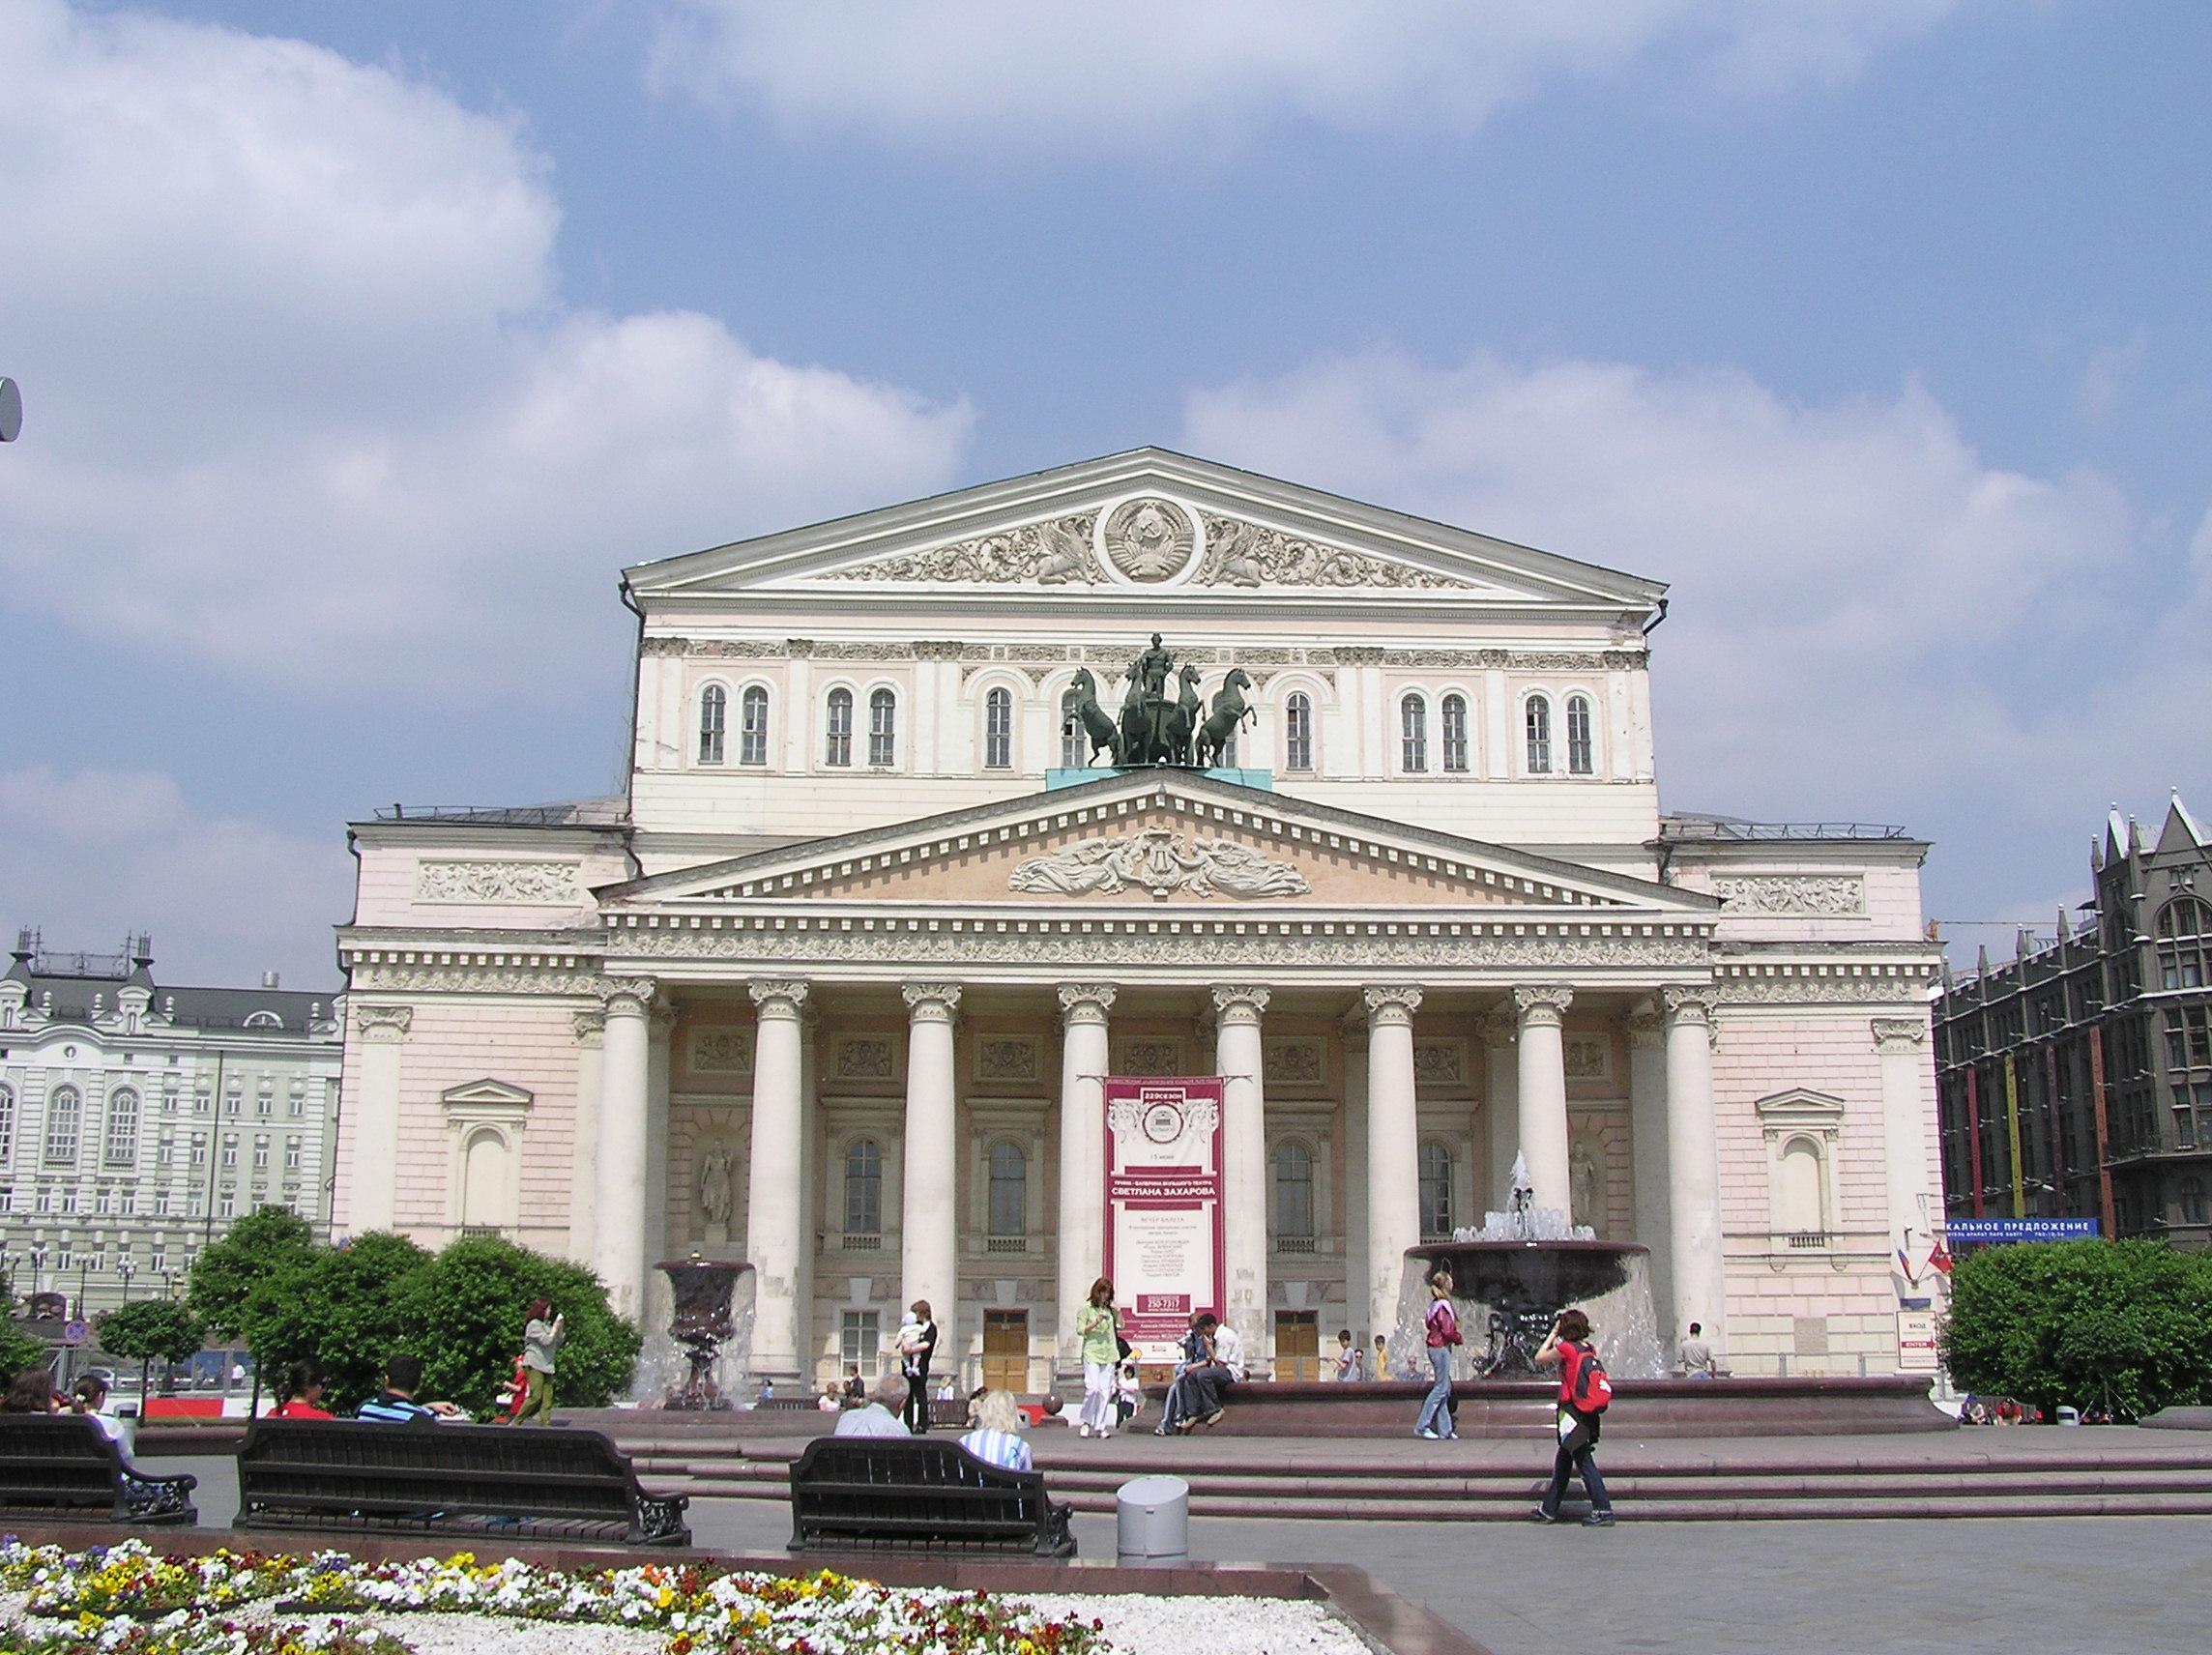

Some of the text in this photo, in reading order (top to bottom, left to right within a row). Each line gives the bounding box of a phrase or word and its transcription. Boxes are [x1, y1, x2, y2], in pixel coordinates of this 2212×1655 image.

[1111, 1187, 1216, 1196] СВЕТЛАНА ЗАХАРОВА
[2003, 1222, 2089, 1232] ПРЕДЛОЖЕНИЕ
